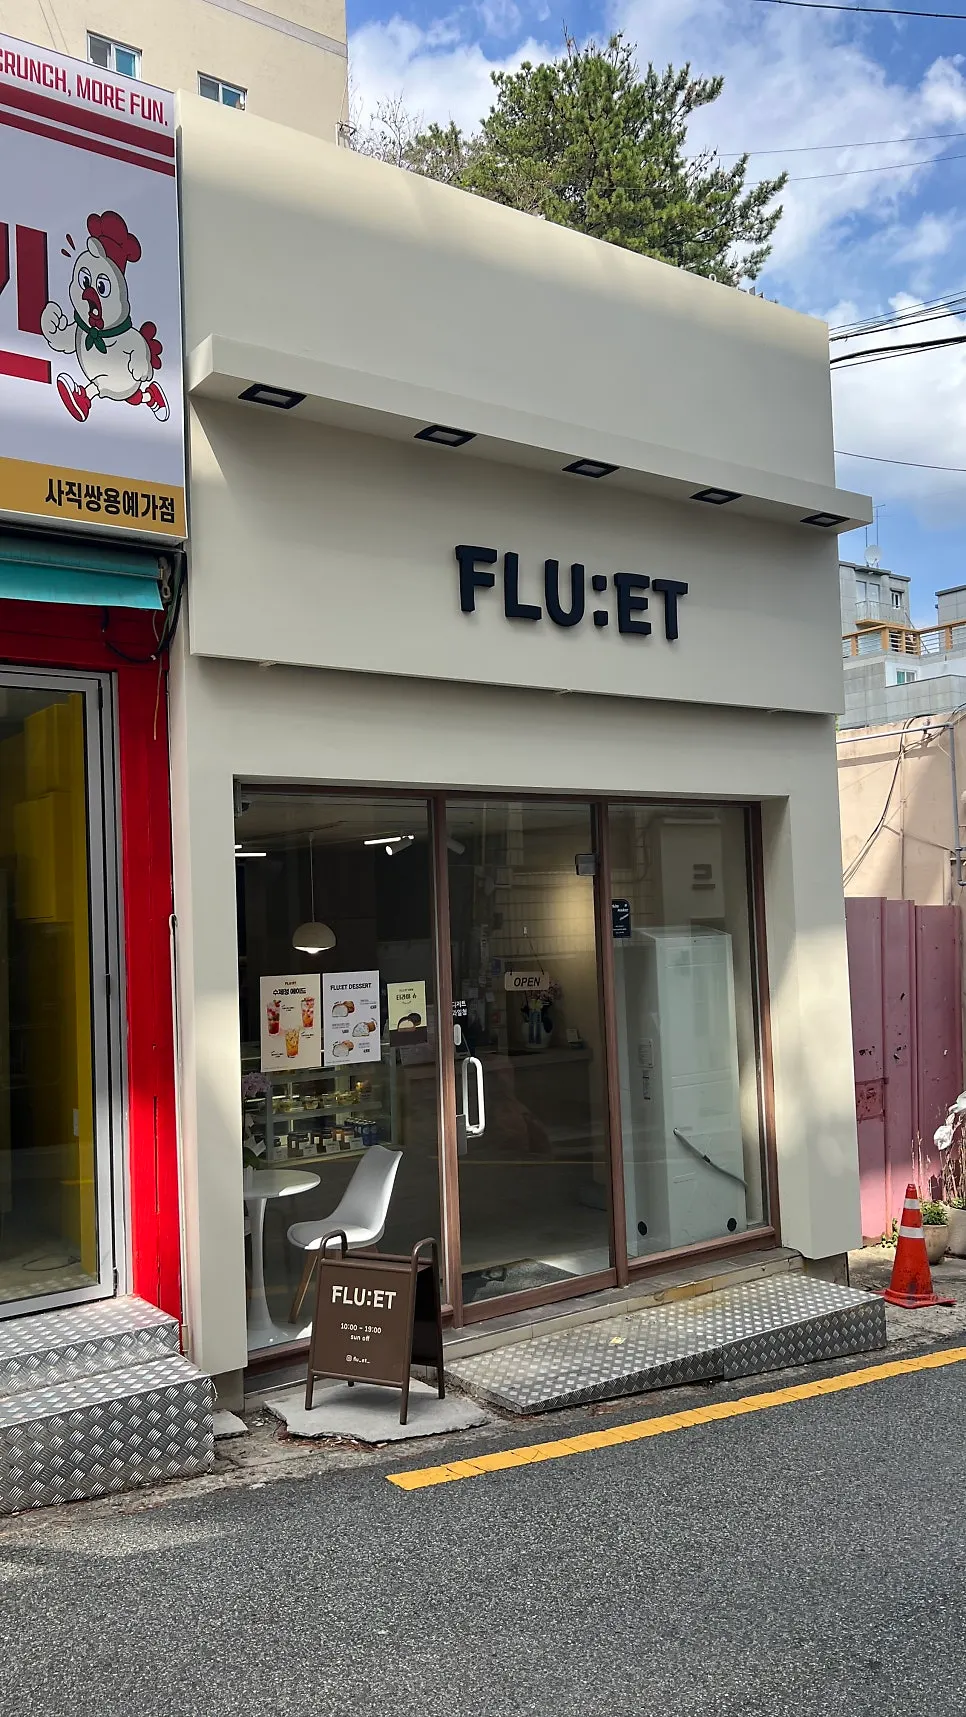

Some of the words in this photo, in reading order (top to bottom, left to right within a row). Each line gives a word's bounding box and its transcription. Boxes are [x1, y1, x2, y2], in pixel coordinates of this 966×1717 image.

[0, 48, 72, 97] RUNCH,
[76, 74, 126, 112] MORE
[130, 91, 168, 127] FUN.
[45, 478, 175, 524] 사직쌍용예가점
[455, 544, 689, 641] FLU:ET
[348, 982, 372, 990] DESSERT
[513, 977, 541, 987] OPEN
[331, 1285, 397, 1310] FLU:ET
[340, 1322, 358, 1331] 10:00
[364, 1325, 382, 1334] 19:00
